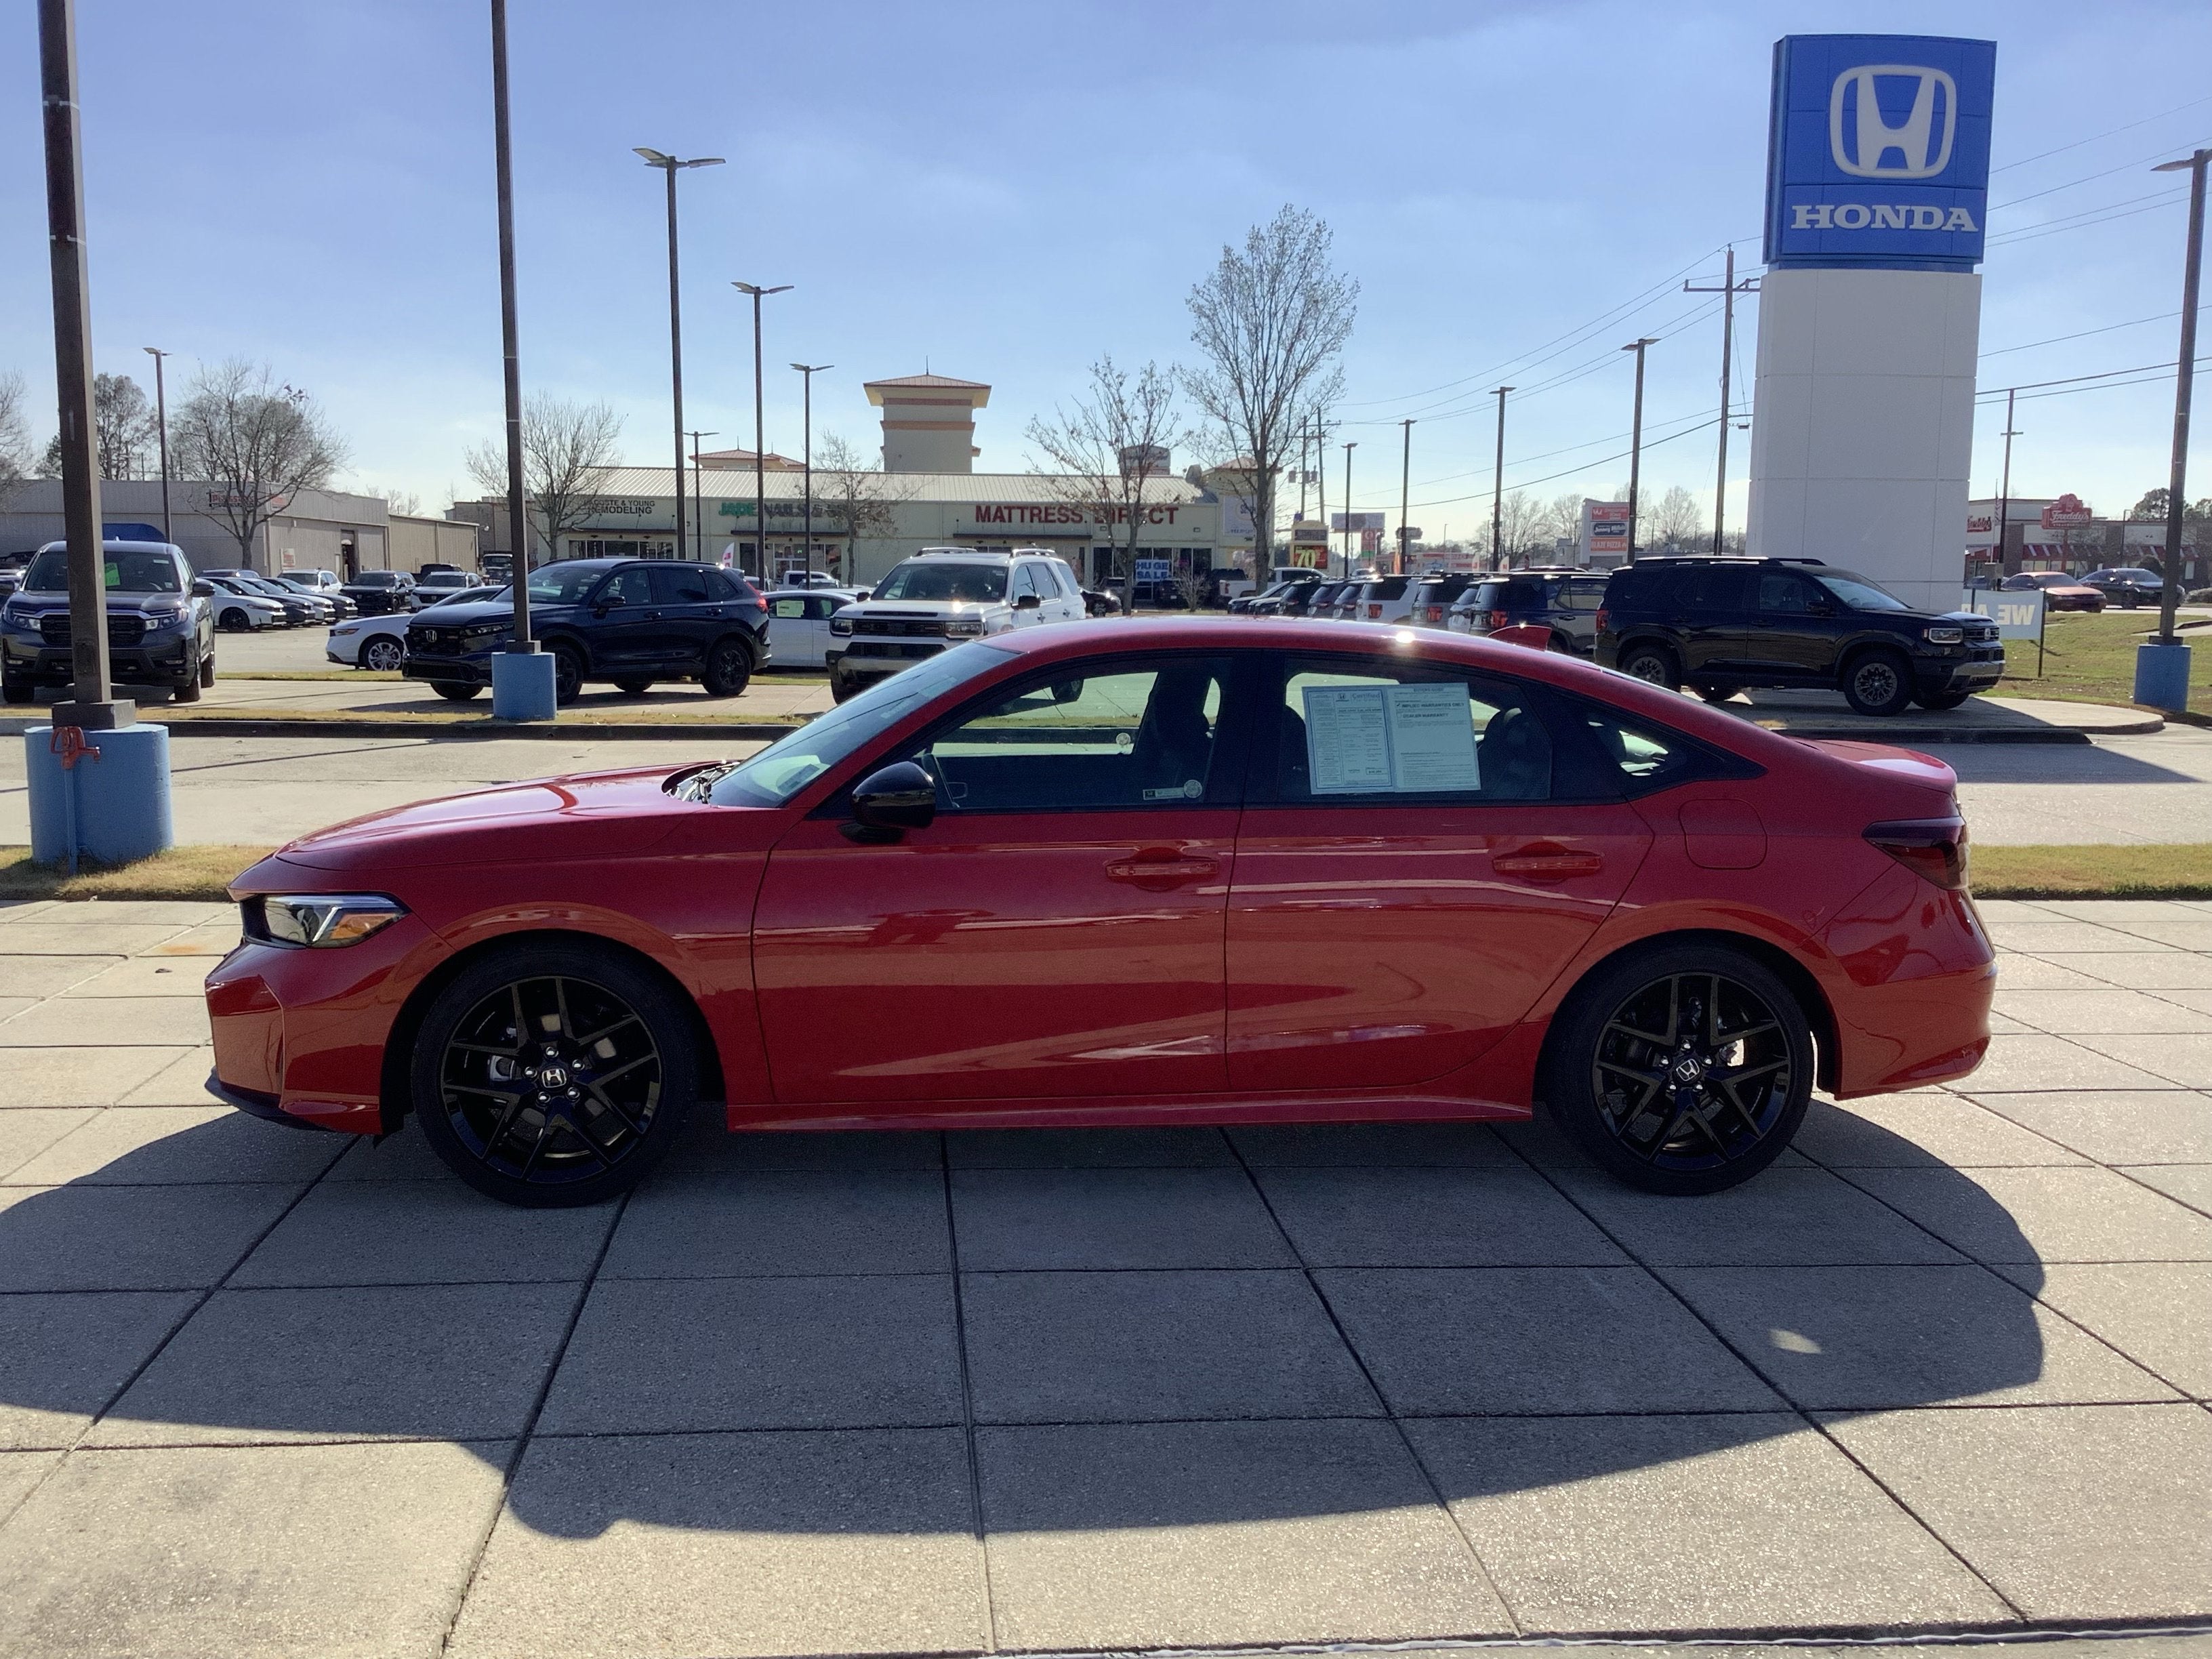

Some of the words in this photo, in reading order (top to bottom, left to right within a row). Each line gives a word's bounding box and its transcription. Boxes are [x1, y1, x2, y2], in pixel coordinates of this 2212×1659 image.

[1790, 203, 1979, 232] HONDA
[975, 505, 1083, 524] MATTRESS
[2049, 510, 2089, 522] Freddy's
[1137, 562, 1168, 570] HUGE
[1137, 571, 1168, 579] SALE
